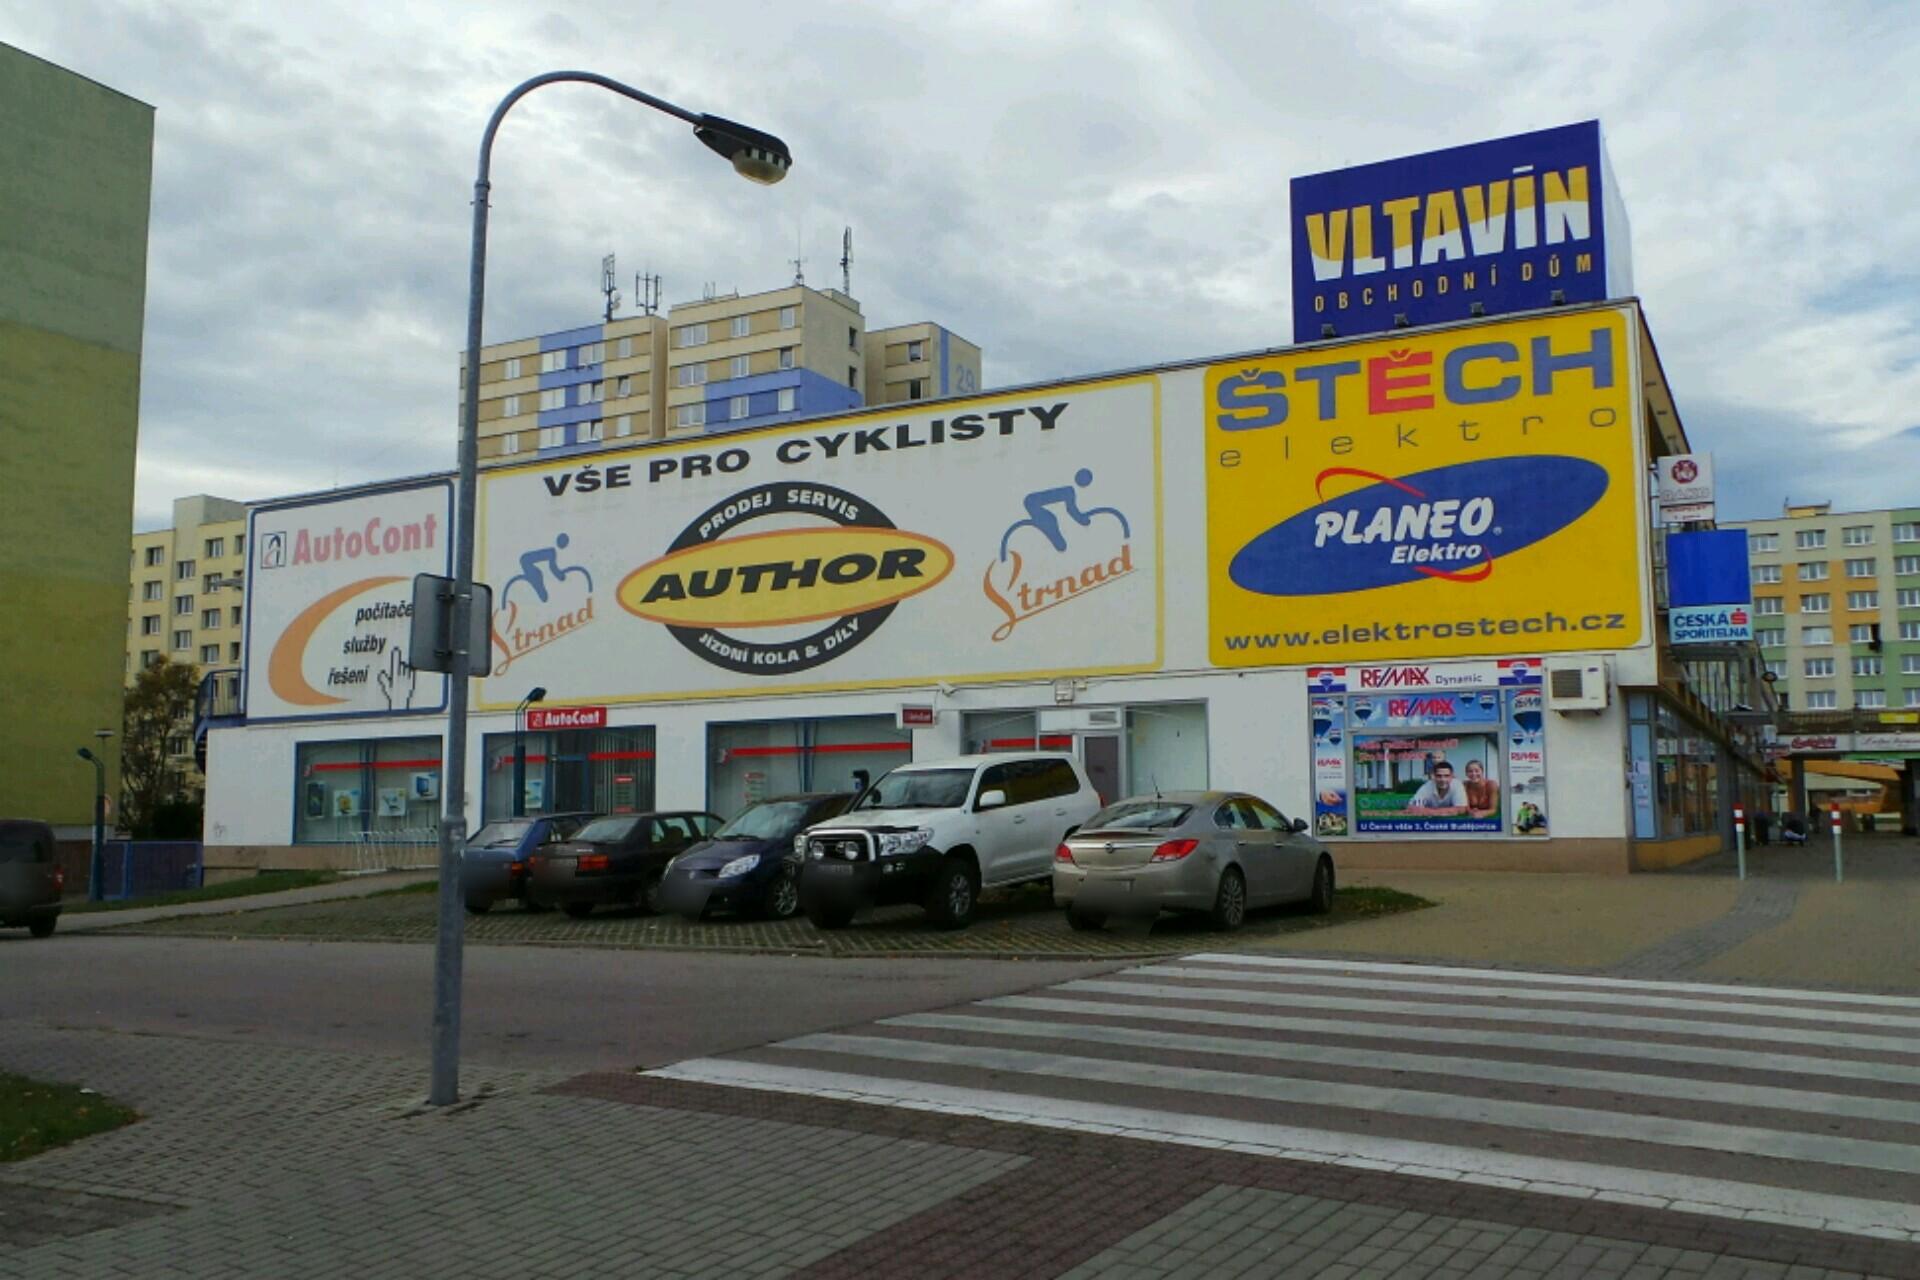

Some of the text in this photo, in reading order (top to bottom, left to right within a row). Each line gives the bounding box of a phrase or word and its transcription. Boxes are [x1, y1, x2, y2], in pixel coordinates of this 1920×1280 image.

[1314, 263, 1497, 313] OBCHODNÍ
[1215, 327, 1615, 432] ŠTĚCH
[543, 402, 1070, 497] VŠE PRO CYKLISTY
[1219, 406, 1617, 468] elektro
[292, 513, 438, 566] AutoCont
[699, 488, 860, 540] PRODEJ SERVIS
[1313, 497, 1495, 548] PLANEO
[639, 547, 928, 604] AUTHOR
[1390, 542, 1482, 564] Elektro
[983, 544, 1136, 642] Strnad
[492, 597, 594, 676] Strnad
[699, 616, 860, 667] JÍZDNÍ KOLA & DÍLY
[1225, 612, 1626, 651] www.elektrostech.cz
[1673, 610, 1730, 628] ČESKÁ
[343, 635, 387, 656] služby
[327, 663, 369, 687] řešení
[1360, 667, 1483, 689] RE/MAX Dynamic
[544, 710, 600, 726] AutoCont
[1388, 697, 1456, 718] RE/MAX
